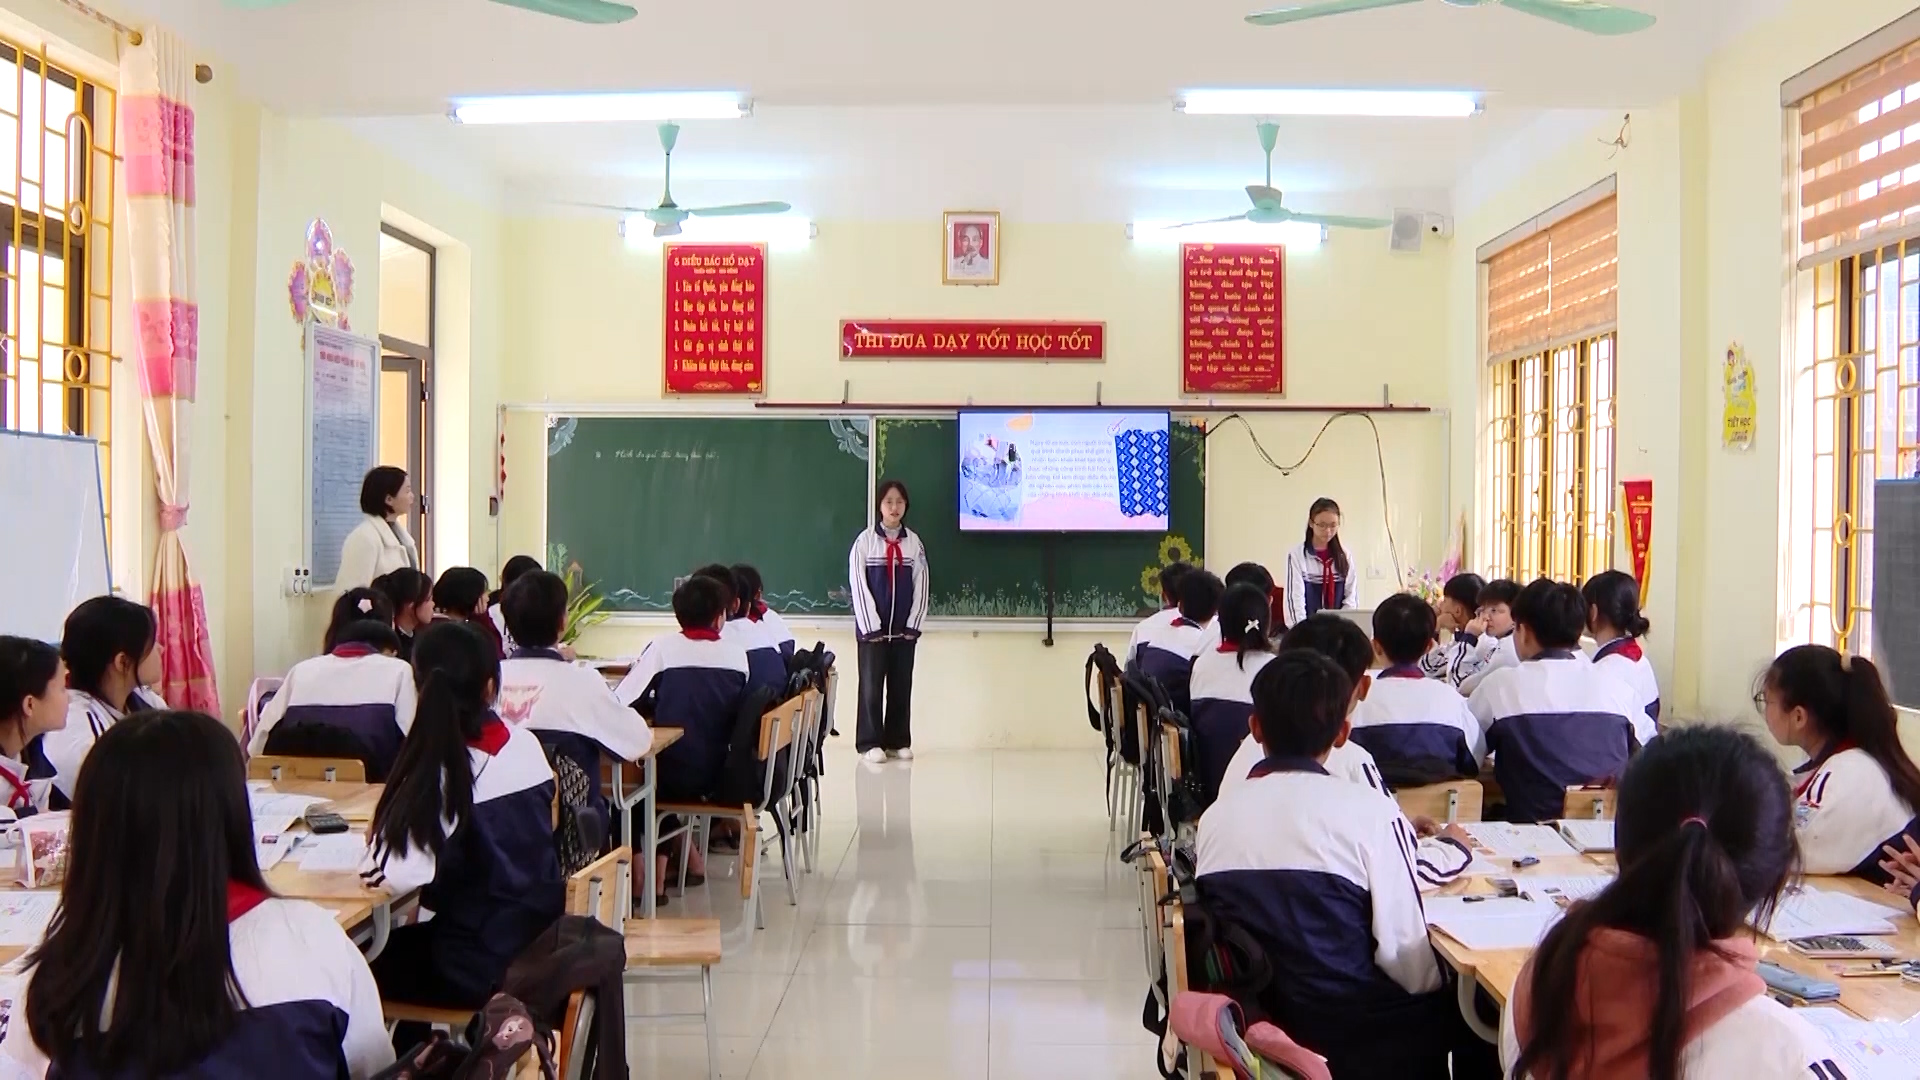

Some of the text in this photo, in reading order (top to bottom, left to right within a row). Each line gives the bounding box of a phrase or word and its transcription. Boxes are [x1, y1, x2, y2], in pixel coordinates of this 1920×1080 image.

[704, 254, 720, 266] BÁC
[737, 257, 755, 267] DẠY
[854, 328, 1092, 353] THI ĐUA DẠY TỐT HỌC TỐT
